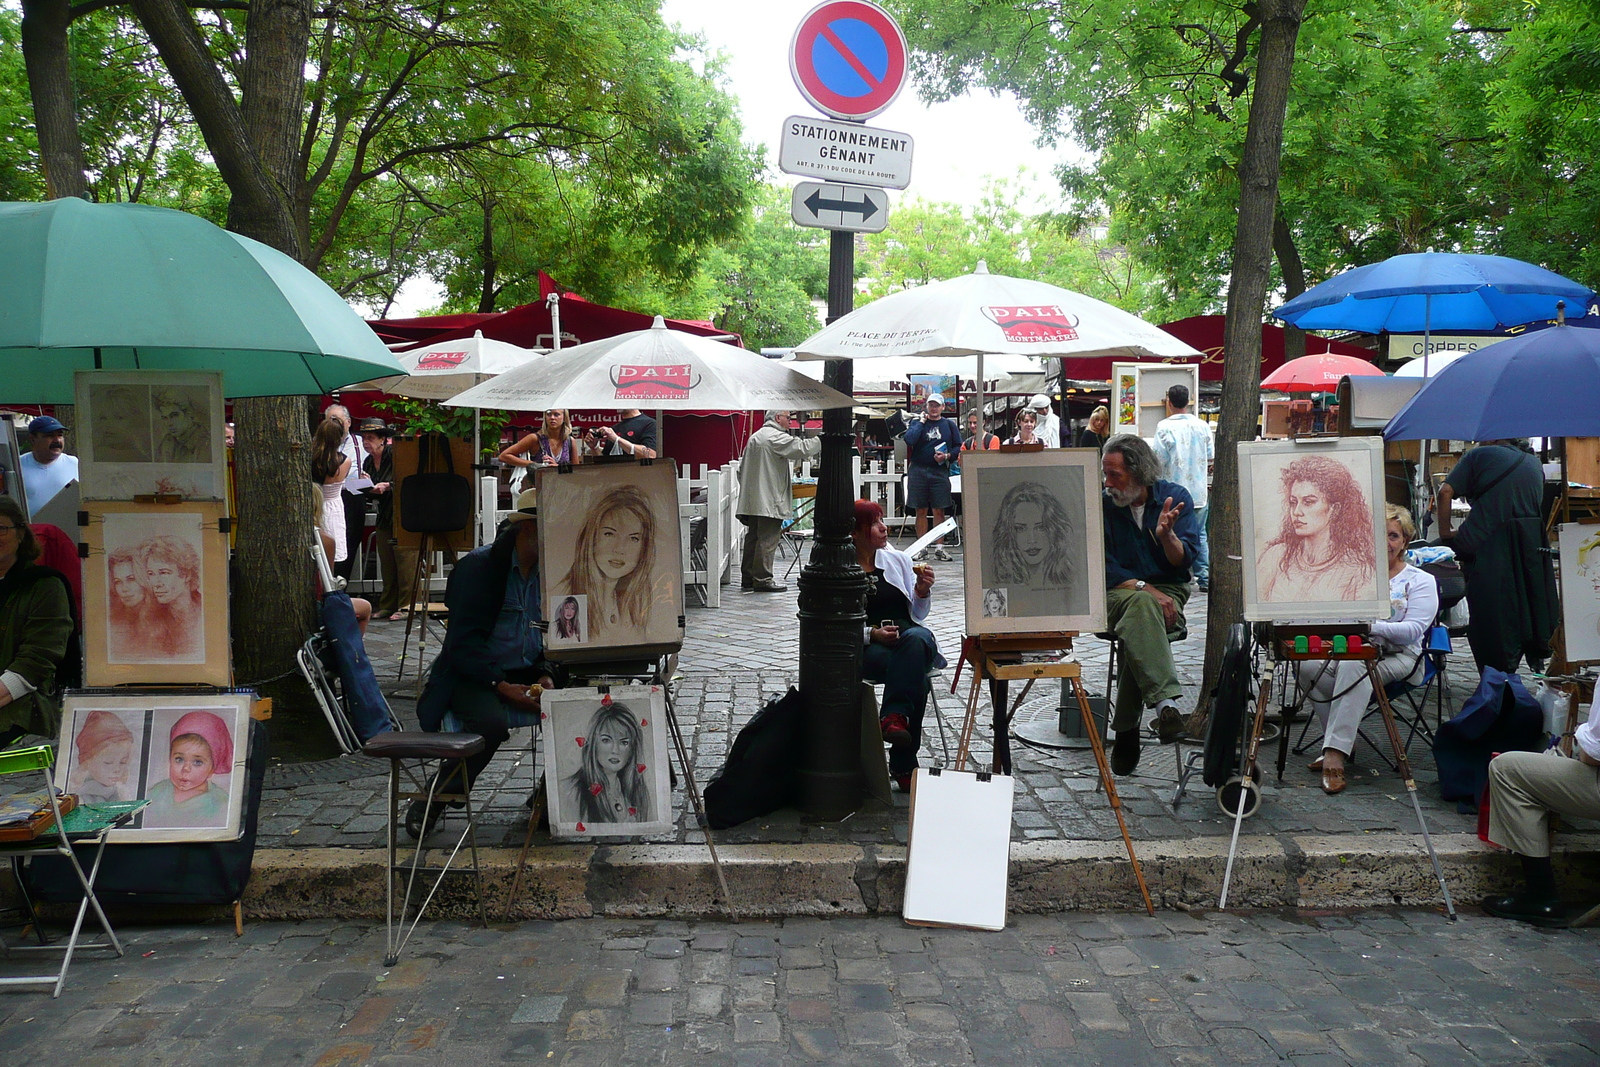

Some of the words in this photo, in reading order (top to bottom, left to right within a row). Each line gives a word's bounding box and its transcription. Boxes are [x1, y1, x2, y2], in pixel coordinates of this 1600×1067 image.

[791, 123, 907, 152] STATIONNEMENT
[820, 145, 875, 165] GÊNANT
[796, 160, 810, 168] ART.
[847, 331, 881, 340] PLACE
[900, 328, 940, 338] TERTRE
[1007, 333, 1079, 342] MONTMARTRE
